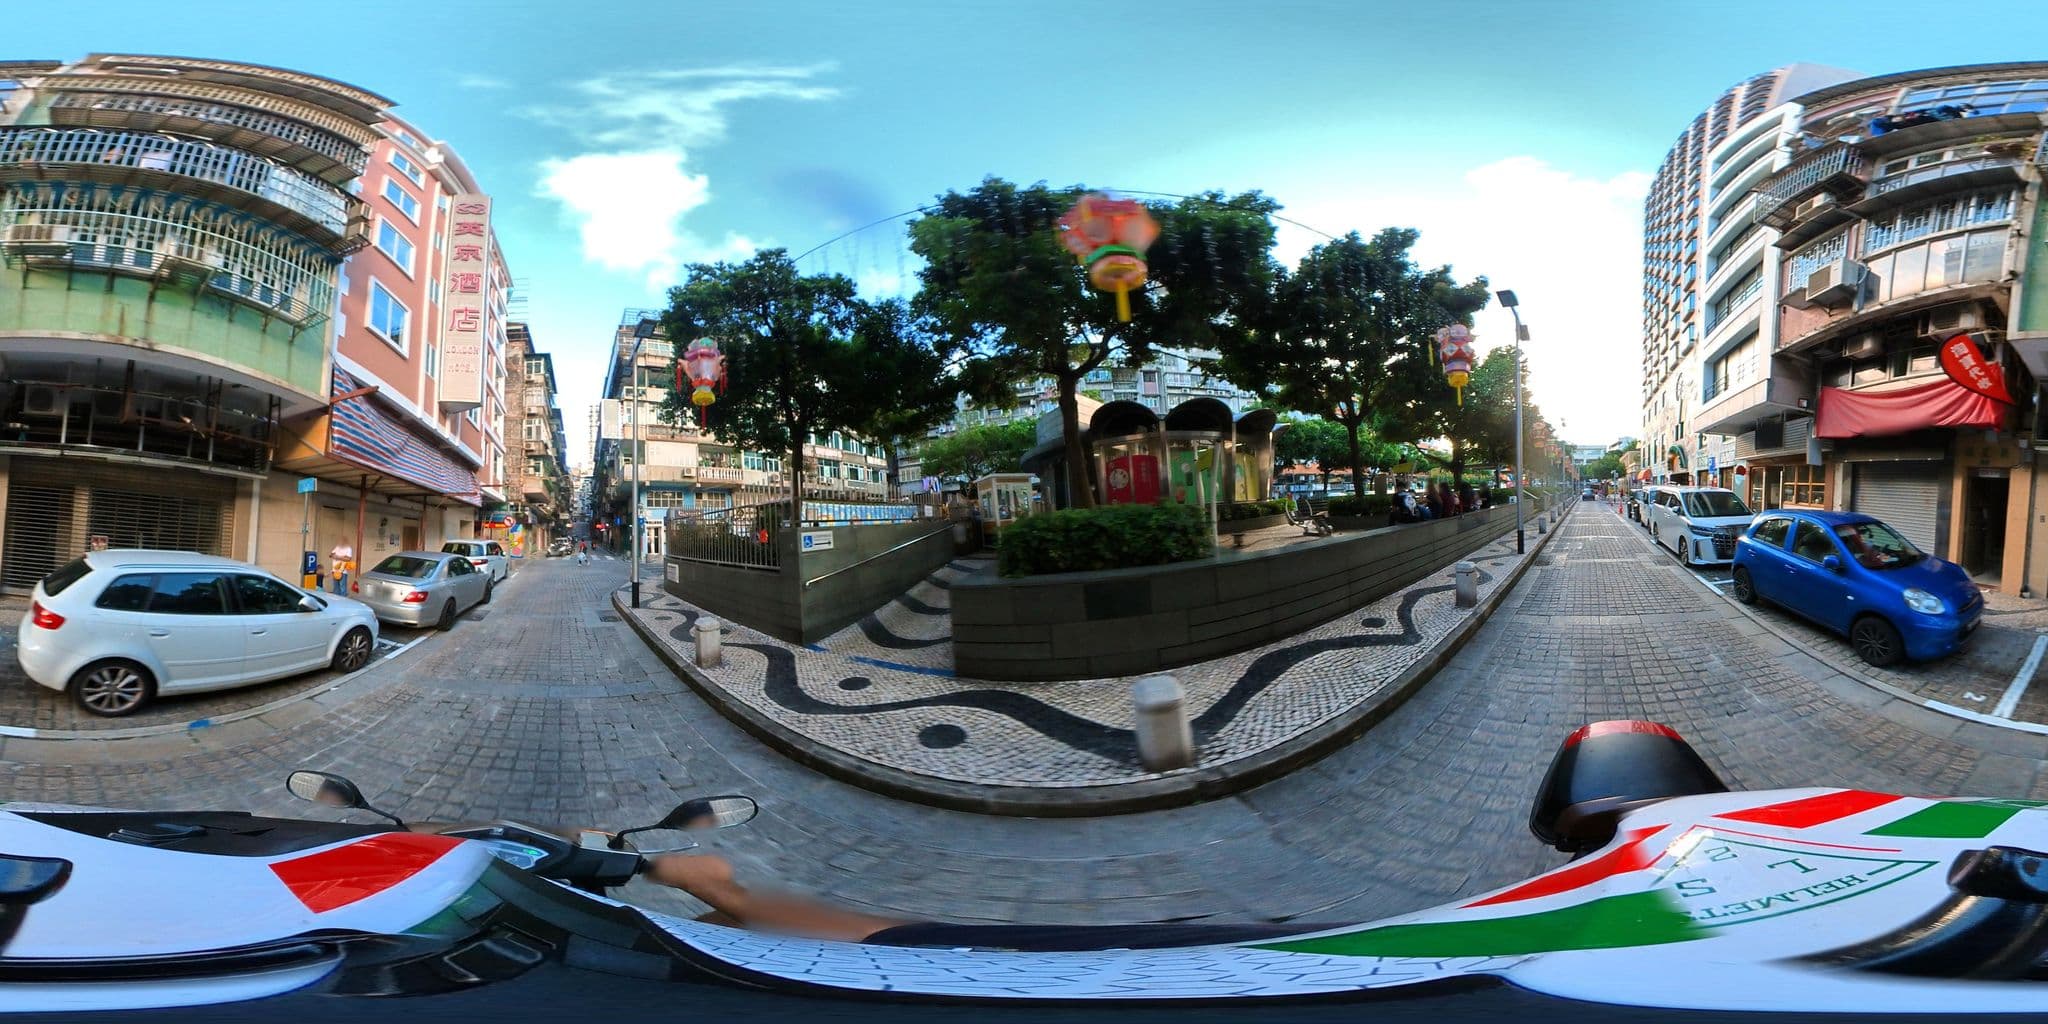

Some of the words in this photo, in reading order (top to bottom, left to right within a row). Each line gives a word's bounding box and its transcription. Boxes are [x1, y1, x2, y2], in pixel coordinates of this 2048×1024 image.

[449, 221, 484, 332] 英京酒店
[308, 555, 316, 567] P
